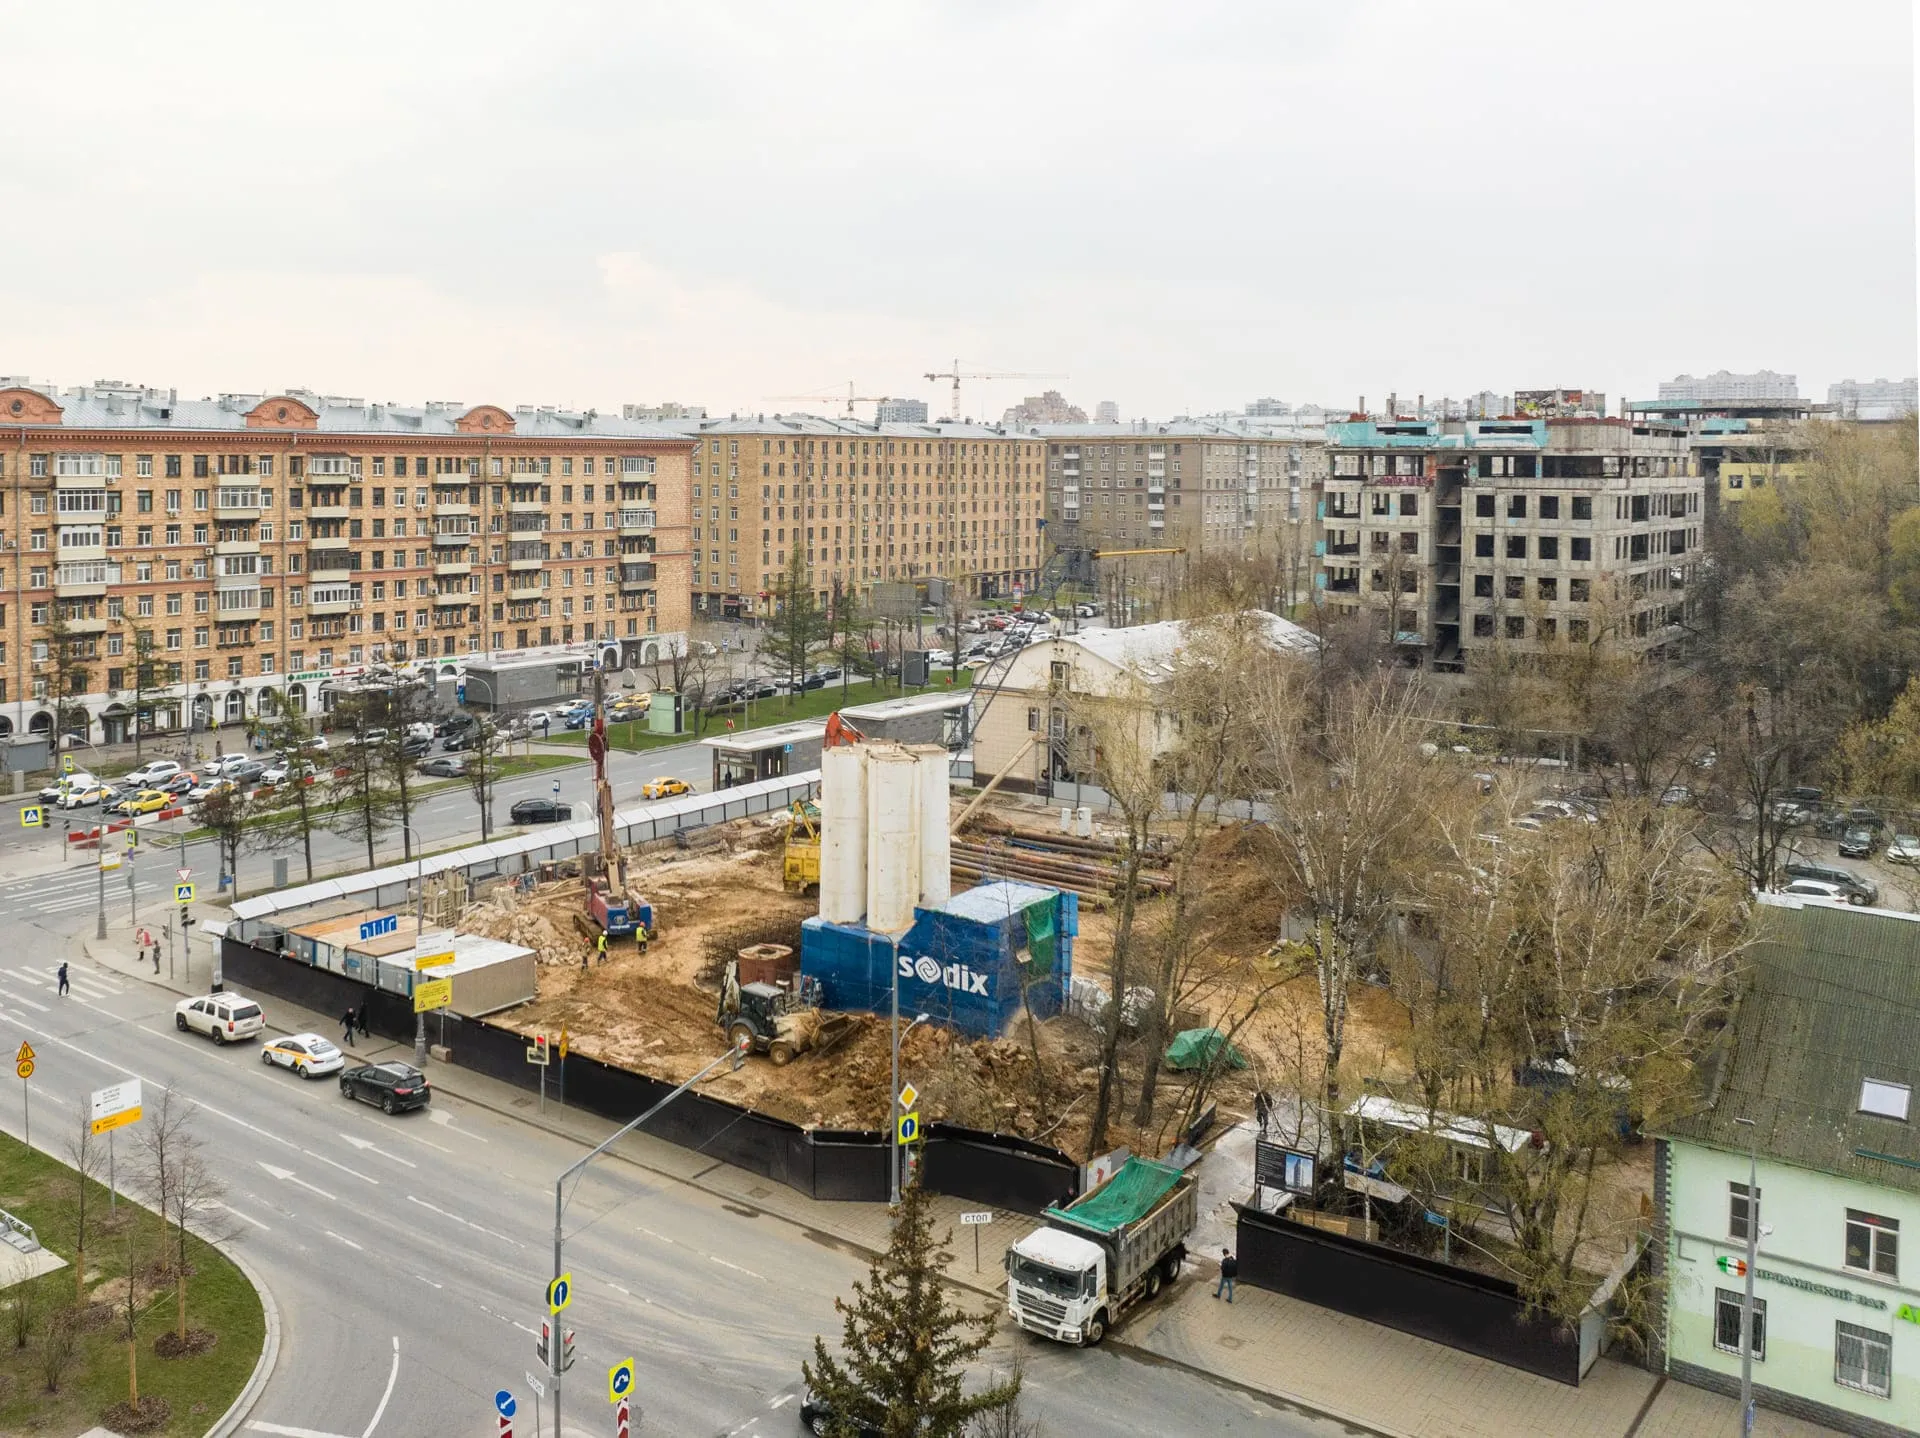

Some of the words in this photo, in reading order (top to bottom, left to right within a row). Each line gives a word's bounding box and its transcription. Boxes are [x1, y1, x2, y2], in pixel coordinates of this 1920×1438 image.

[898, 955, 989, 997] sodix
[20, 1064, 31, 1073] 40
[964, 1214, 988, 1222] СТОП
[1896, 1303, 1920, 1325] А
